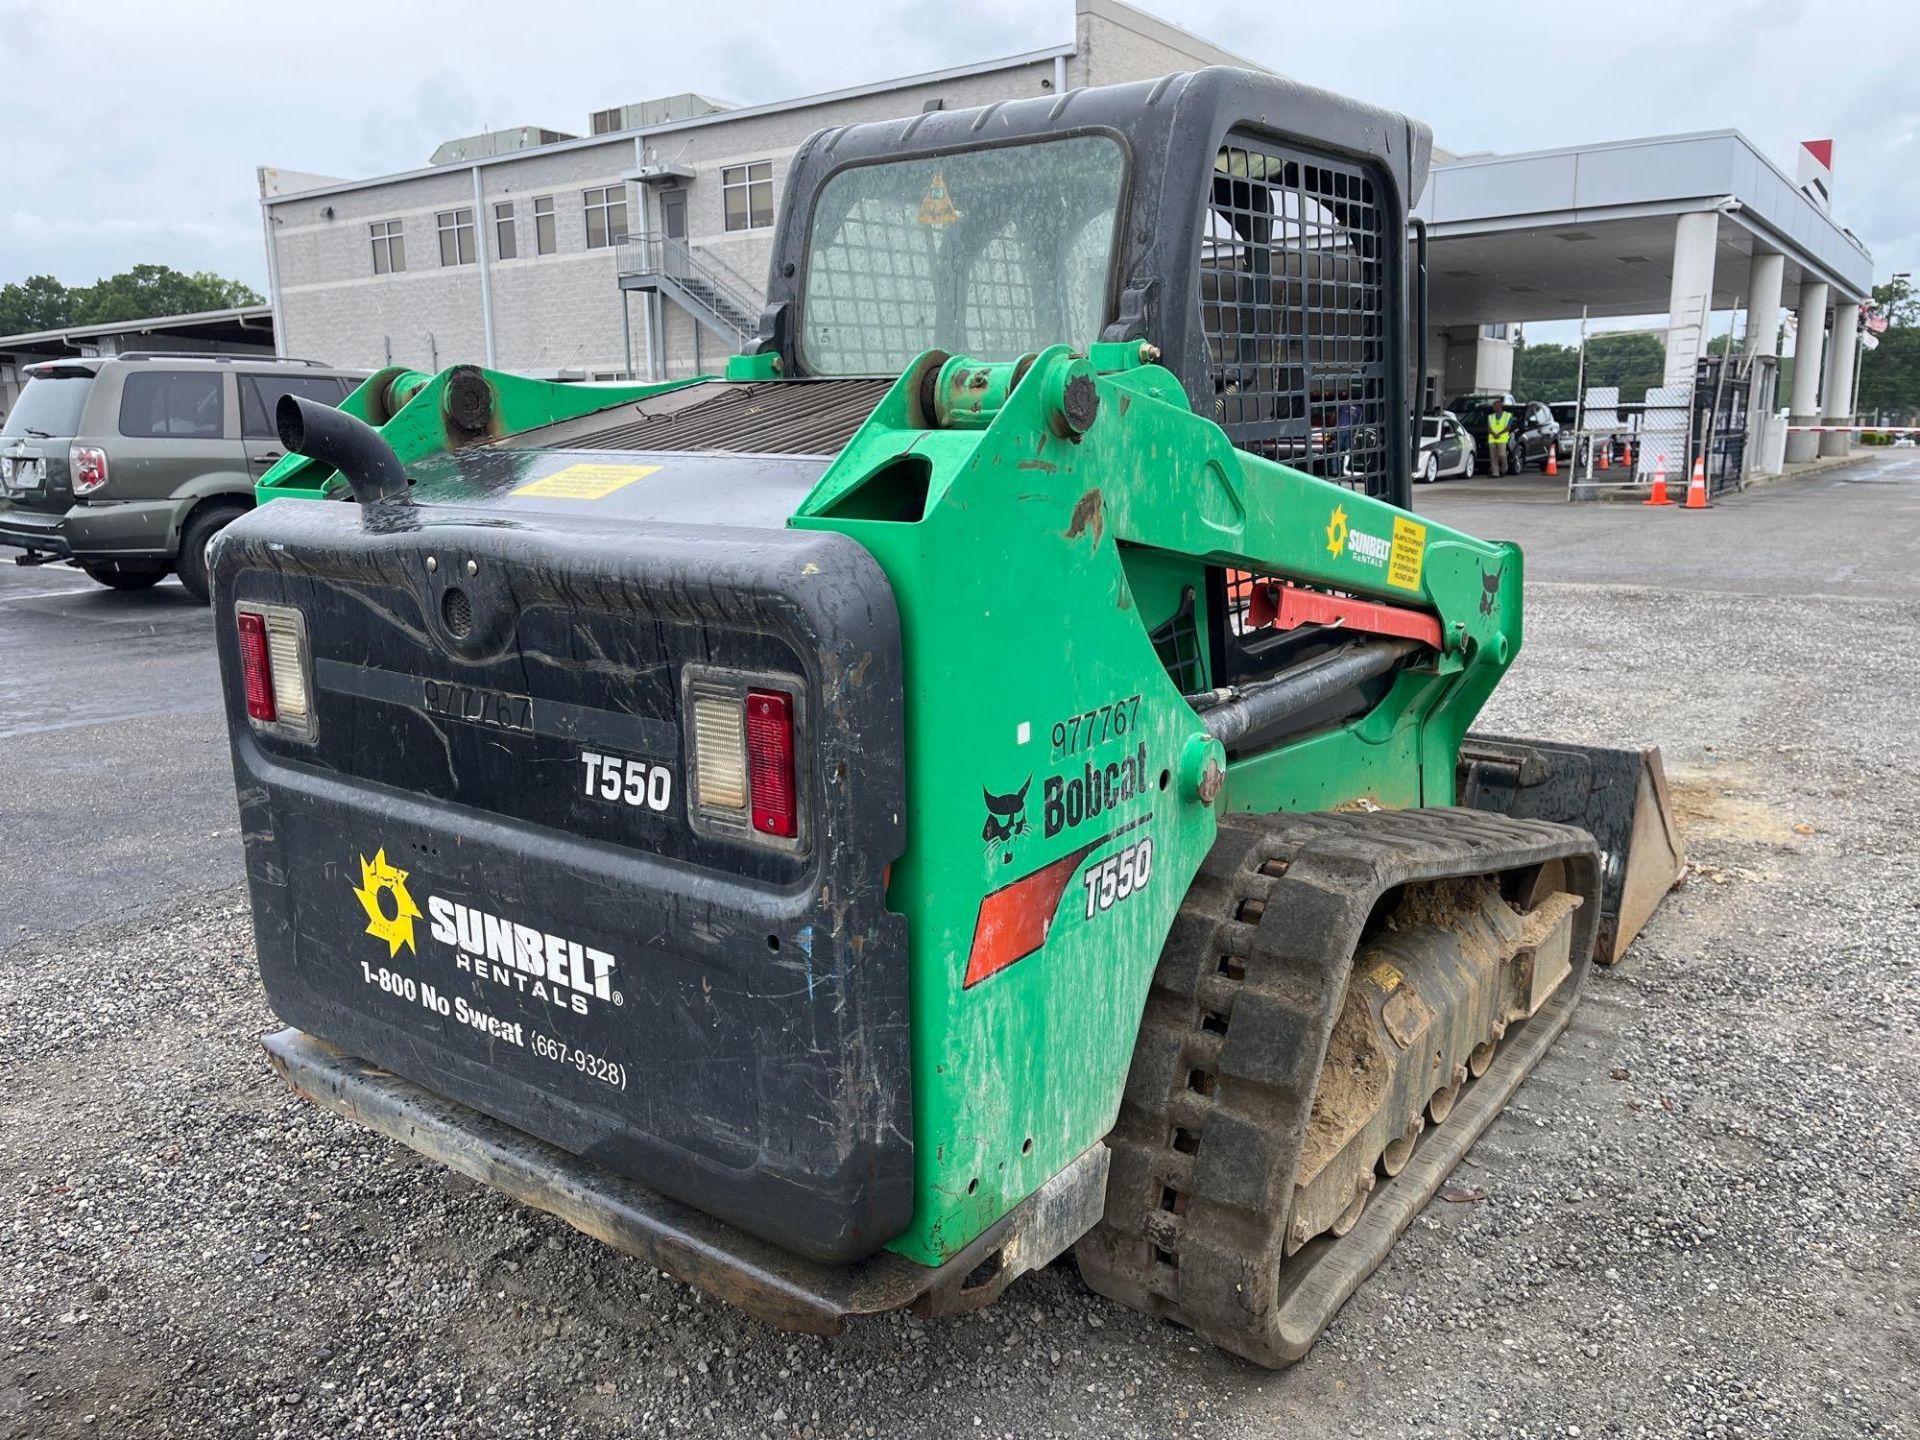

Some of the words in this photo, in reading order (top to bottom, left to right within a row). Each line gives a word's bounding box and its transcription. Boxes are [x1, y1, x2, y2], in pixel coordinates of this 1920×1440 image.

[1348, 529, 1391, 561] SUNBELT
[1052, 695, 1142, 757] 977767
[582, 751, 671, 811] T550
[1044, 741, 1148, 839] Bobcat
[1084, 836, 1154, 922] T550
[427, 895, 616, 1002] SUNBELT
[456, 953, 589, 1016] RENTALS
[360, 960, 417, 1002] 1-800
[420, 982, 450, 1017] No
[455, 996, 524, 1048] Sweat
[531, 1029, 627, 1092] (667-9328)
